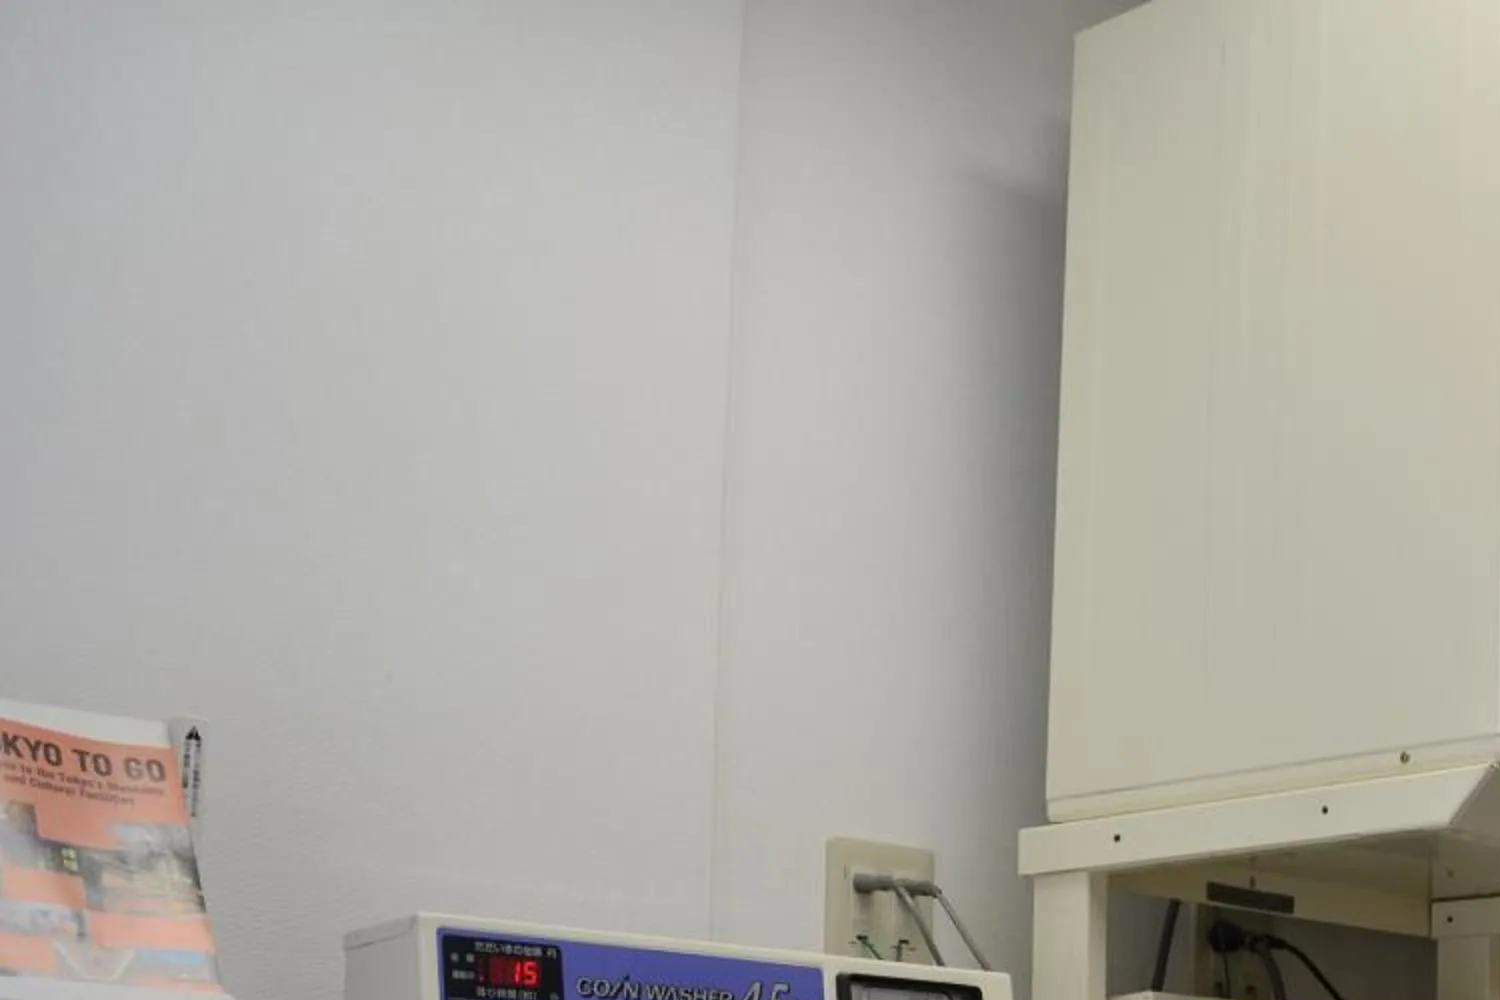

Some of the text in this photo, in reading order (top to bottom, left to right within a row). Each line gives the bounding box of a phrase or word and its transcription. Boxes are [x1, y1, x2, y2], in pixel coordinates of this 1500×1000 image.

[72, 748, 112, 776] TO
[124, 757, 166, 782] GO
[512, 960, 539, 985] 15
[575, 974, 640, 999] COIN
